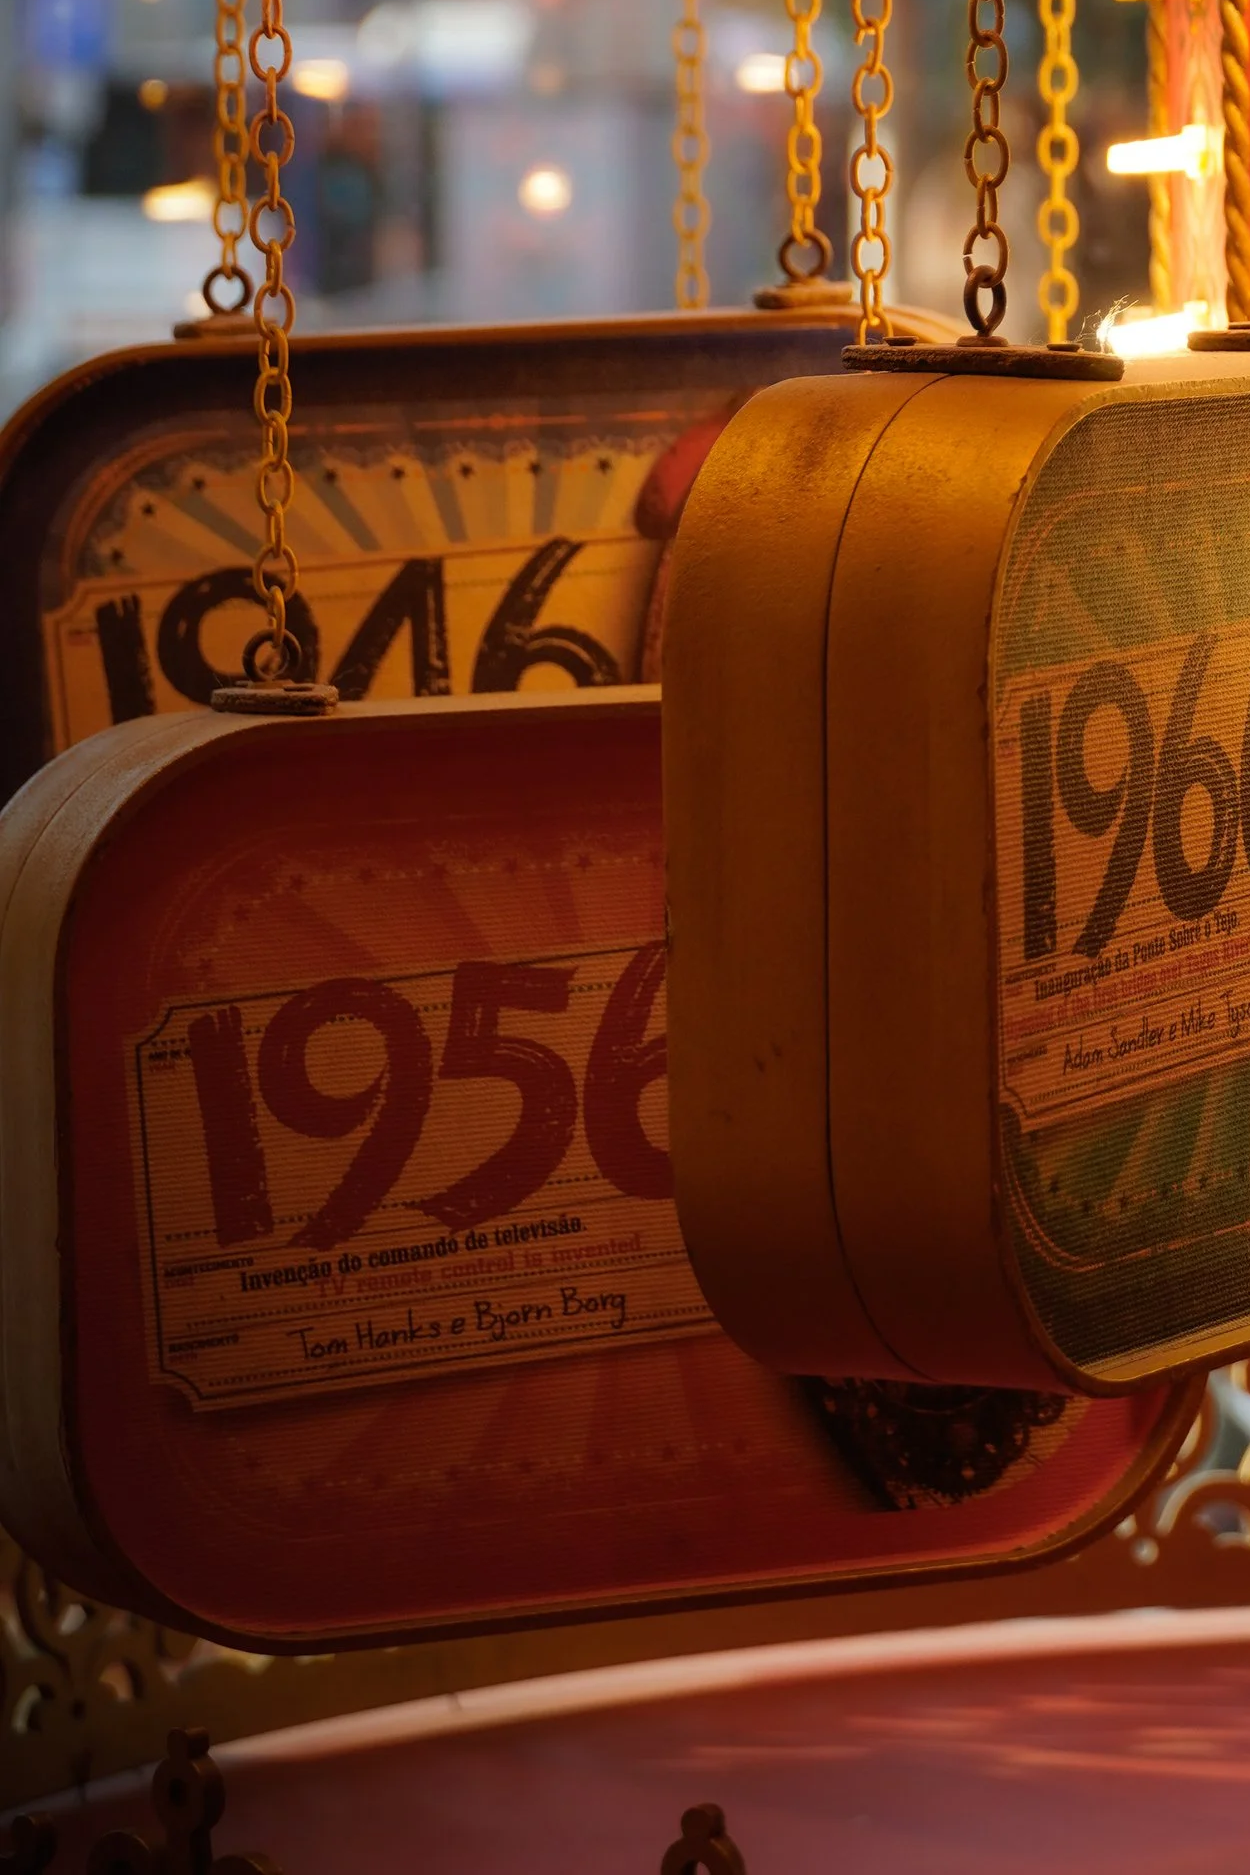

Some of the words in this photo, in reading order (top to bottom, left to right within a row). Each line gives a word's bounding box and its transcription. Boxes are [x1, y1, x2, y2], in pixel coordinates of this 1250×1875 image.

[1034, 956, 1111, 1001] Inauguração
[1114, 948, 1130, 972] da
[1132, 937, 1165, 967] Ponte
[1169, 924, 1200, 951] Sobre
[1062, 1033, 1104, 1075] Adam
[1108, 1015, 1164, 1060] Sandler
[1169, 1022, 1178, 1042] e
[1181, 998, 1216, 1037] Mike
[188, 938, 676, 1251] 1956
[240, 1255, 332, 1292] Invenção
[338, 1252, 362, 1275] do
[368, 1234, 459, 1268] comando
[464, 1229, 488, 1251] de
[494, 1212, 588, 1246] televisão.
[317, 1276, 347, 1300] TV
[356, 1265, 432, 1292] remote
[440, 1252, 516, 1280] control
[523, 1247, 543, 1267] is
[286, 1327, 348, 1360] Tom
[354, 1308, 442, 1350] Hanks
[451, 1316, 466, 1336] e
[474, 1299, 552, 1341] Bjorn
[560, 1285, 627, 1329] Borg
